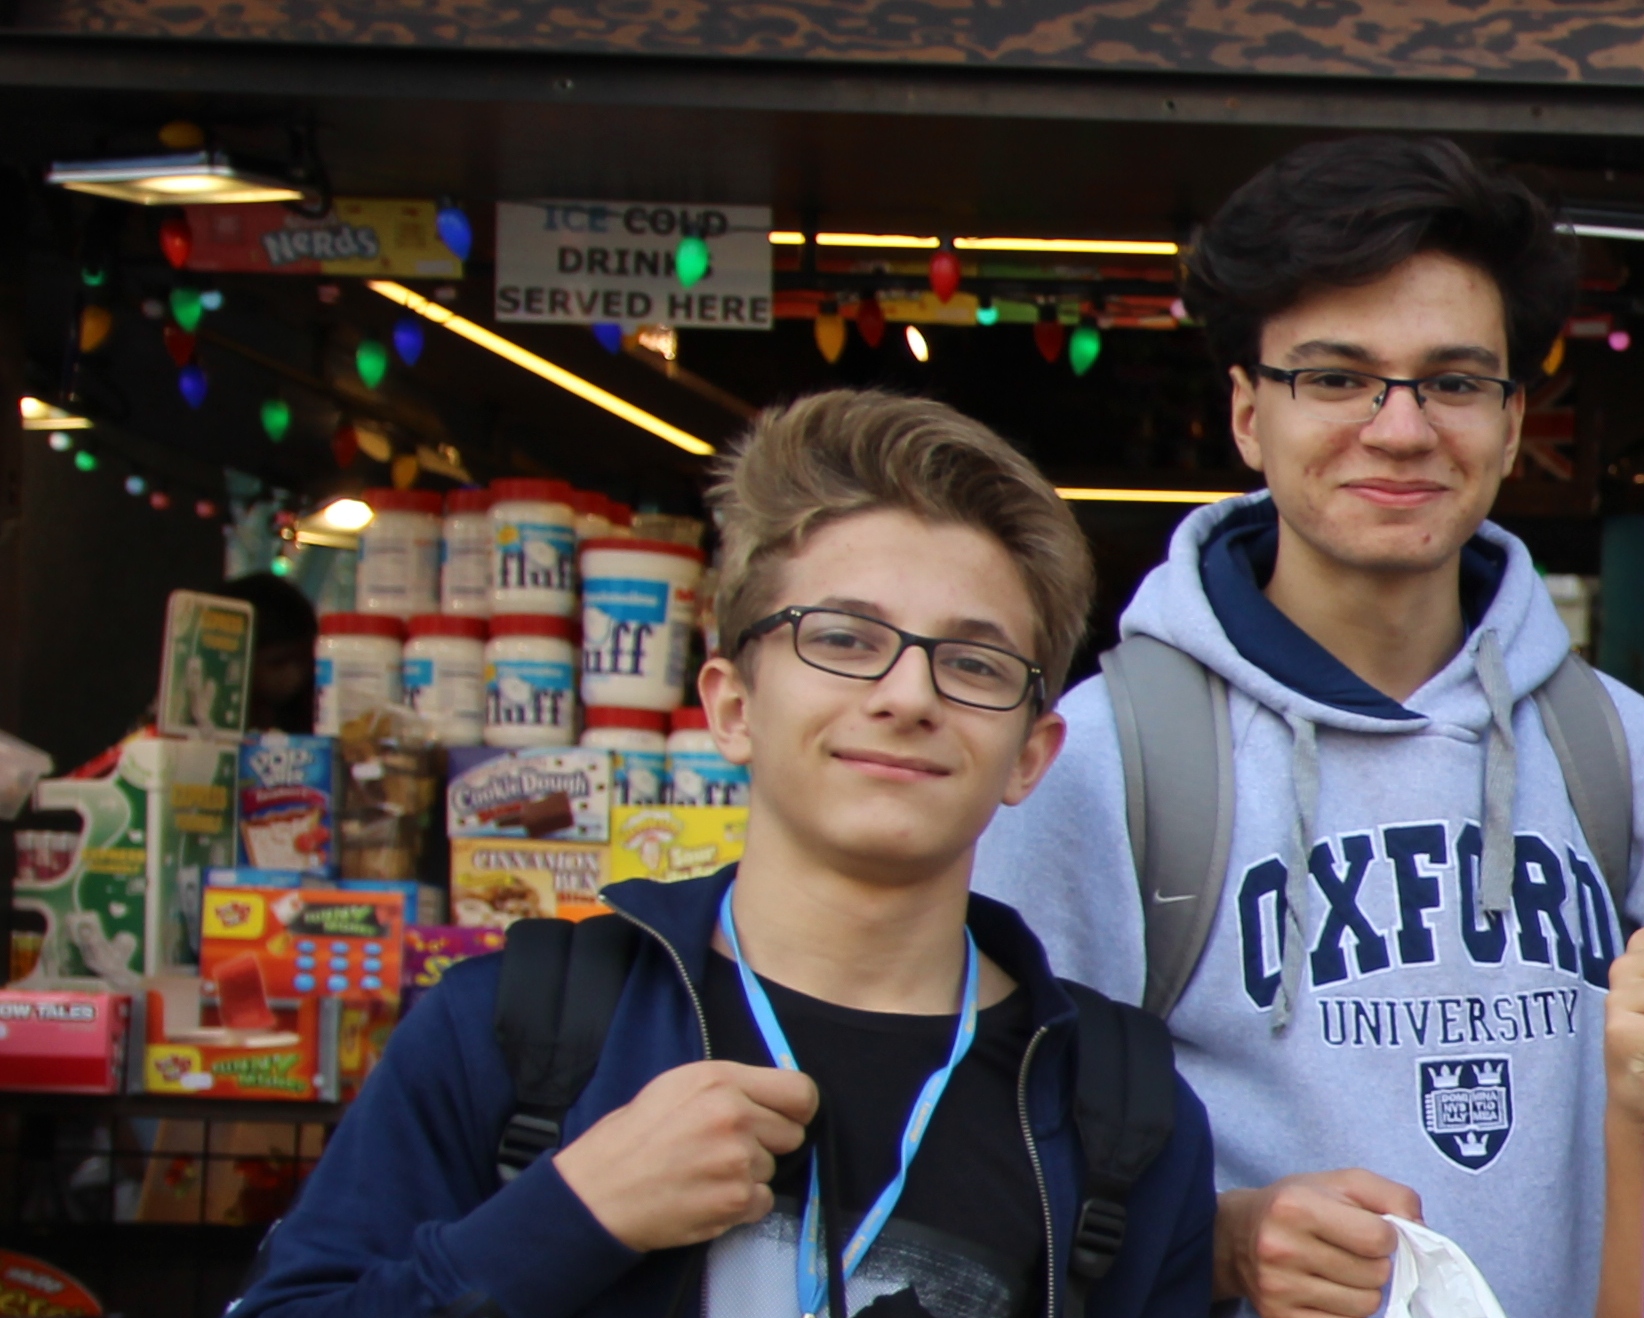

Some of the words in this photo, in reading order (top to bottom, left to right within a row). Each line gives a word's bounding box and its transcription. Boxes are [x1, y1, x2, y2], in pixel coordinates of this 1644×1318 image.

[544, 204, 609, 233] ICE
[557, 246, 715, 278] DRIN
[498, 285, 653, 319] SERVED
[667, 294, 768, 323] HERE
[520, 767, 588, 797] Dough
[1238, 818, 1612, 1012] OXFORD
[0, 1002, 31, 1020] OW
[1317, 987, 1579, 1049] UNIVERSITY
